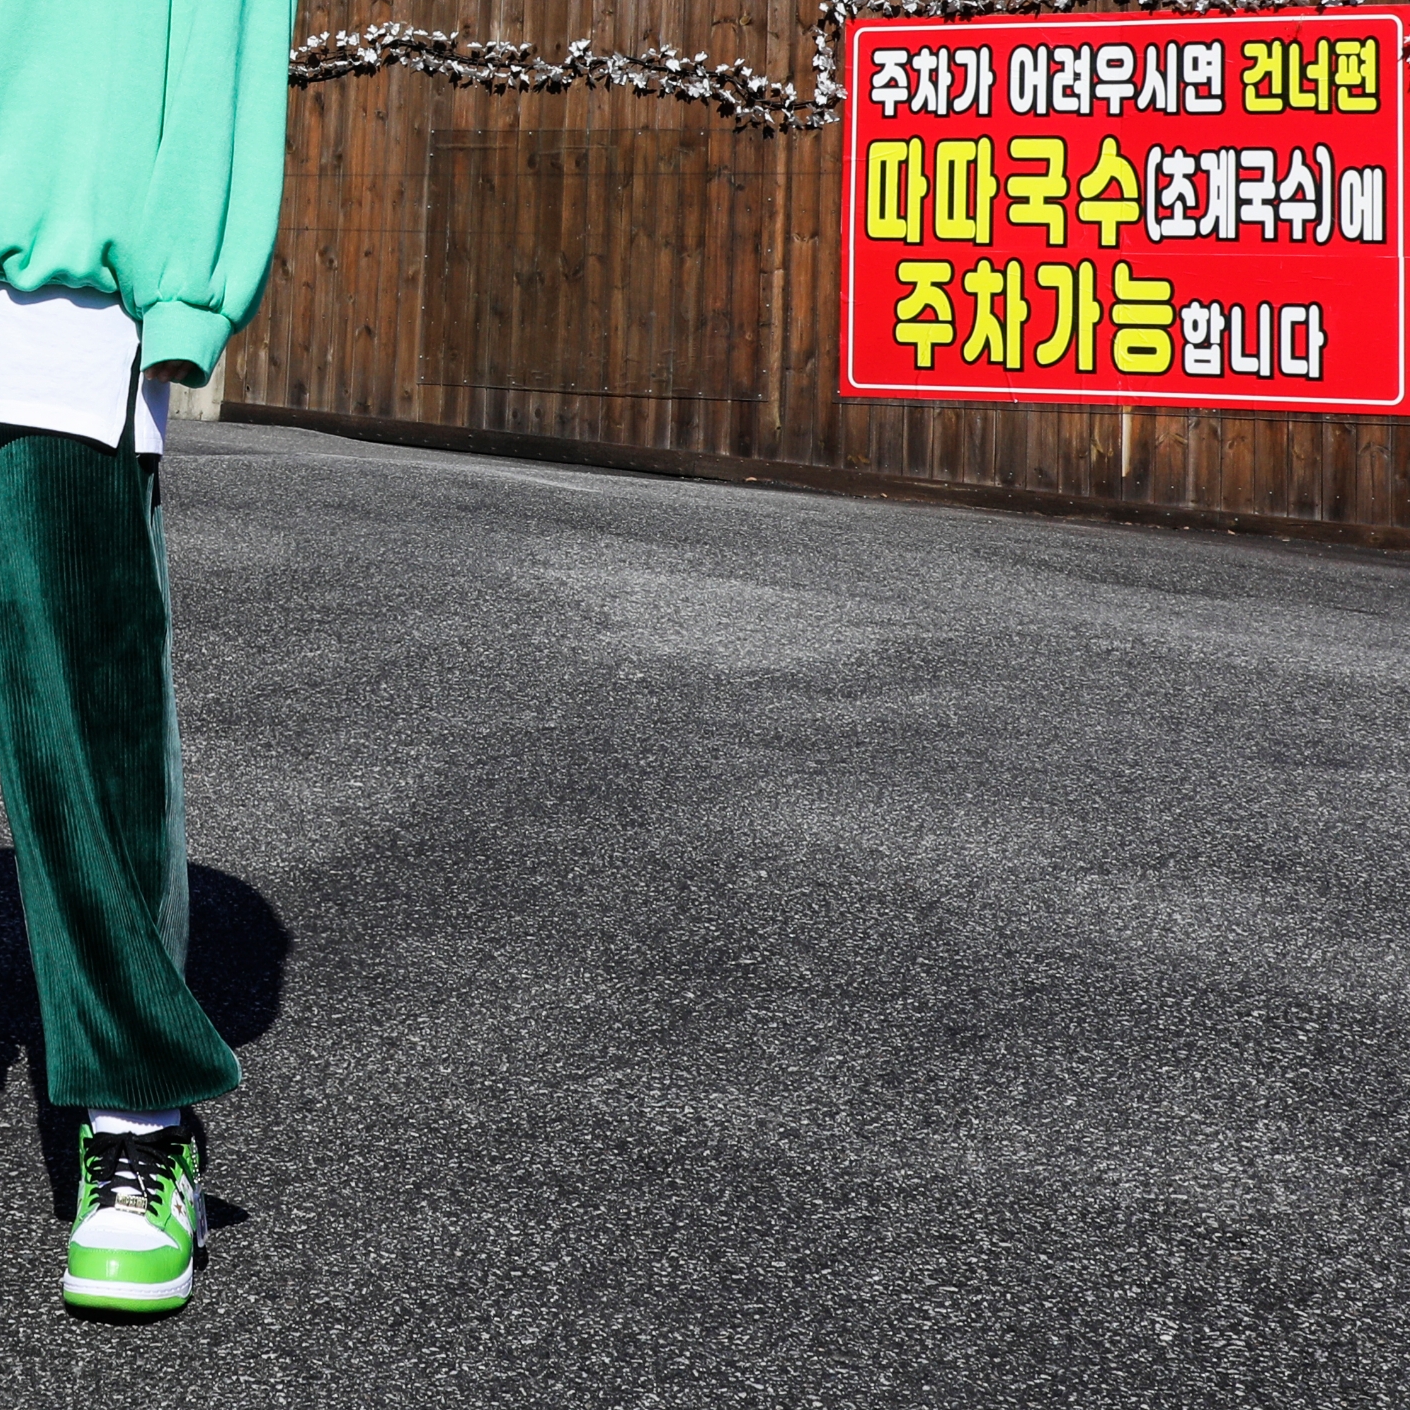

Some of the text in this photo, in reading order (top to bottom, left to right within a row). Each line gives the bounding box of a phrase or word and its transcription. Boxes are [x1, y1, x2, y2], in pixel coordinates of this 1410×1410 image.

[870, 38, 1378, 116] 주차가 어려우시면 건너편
